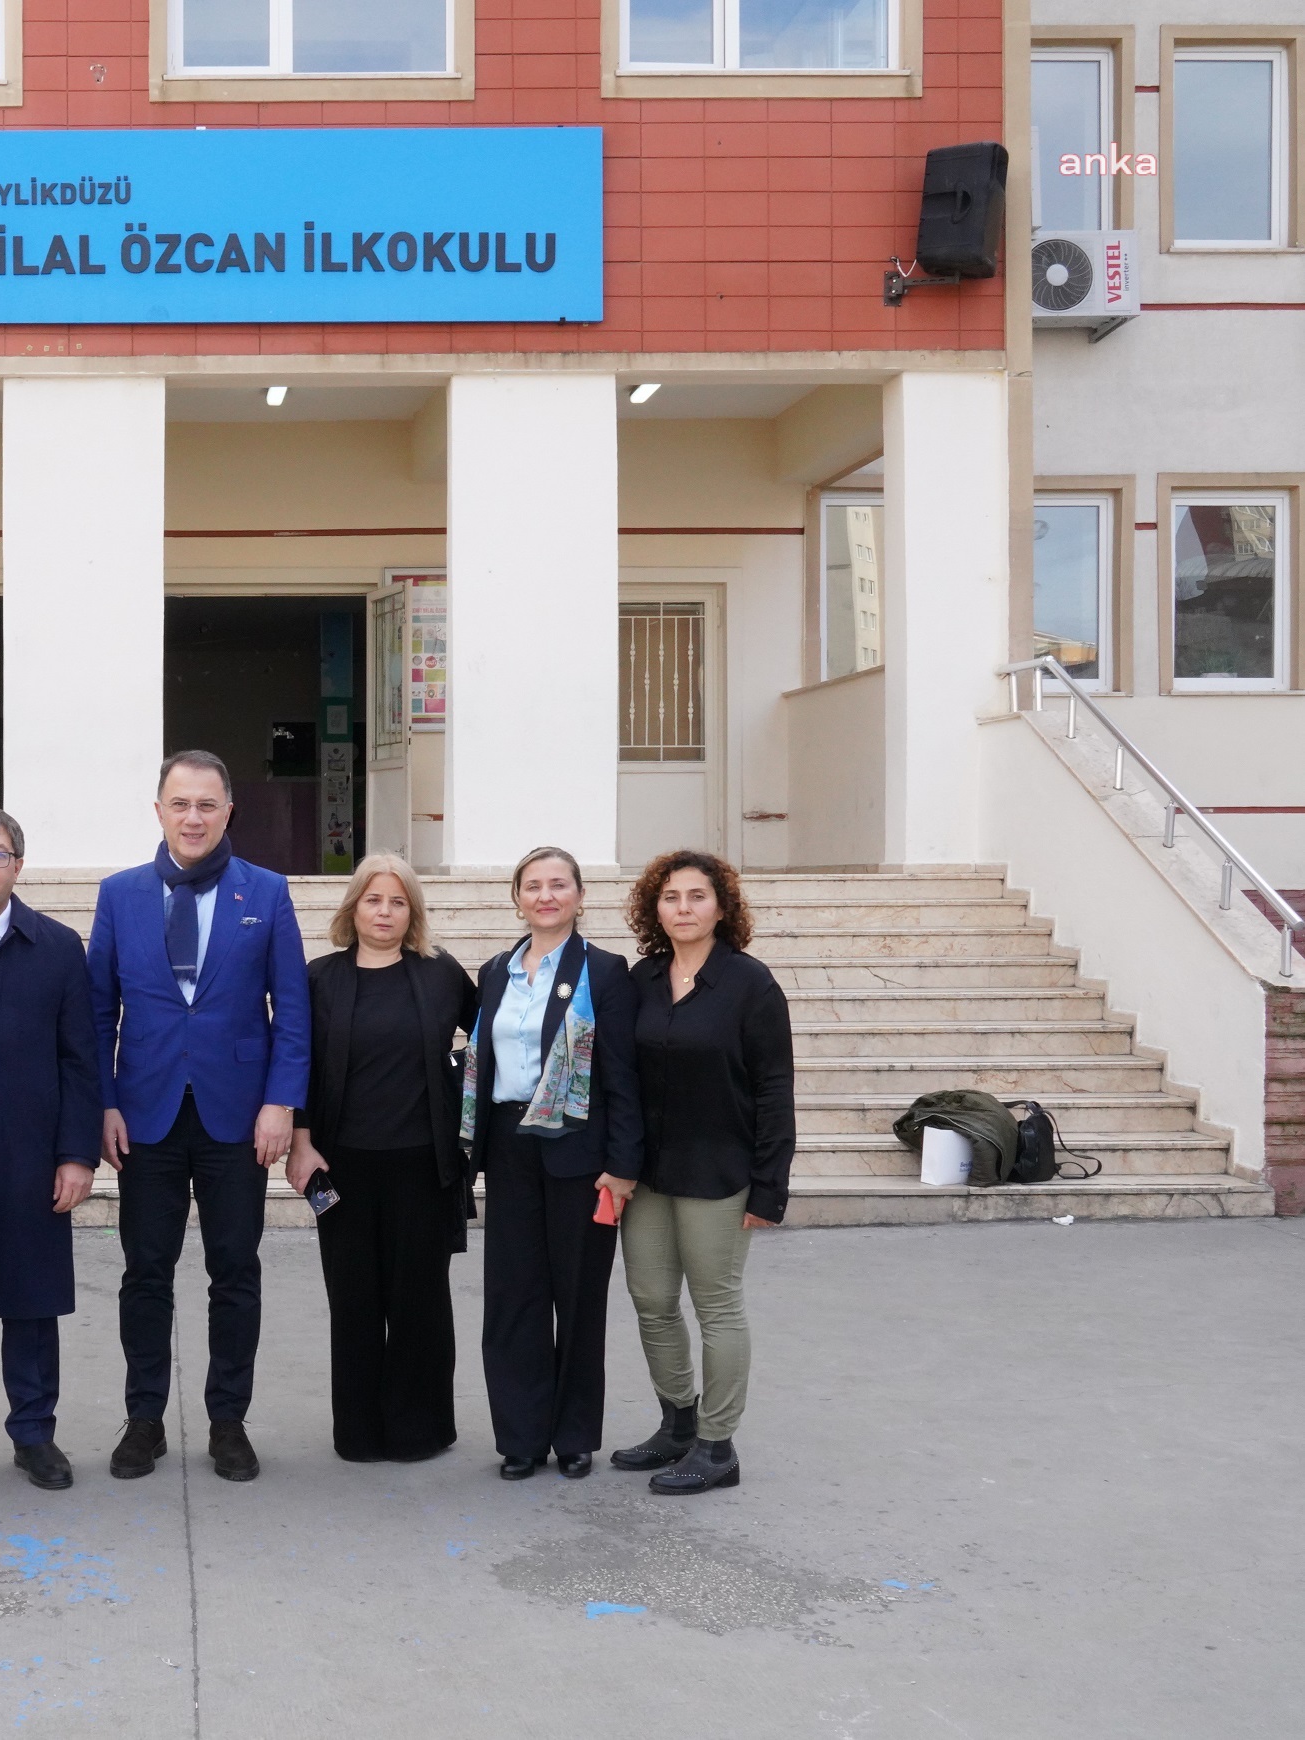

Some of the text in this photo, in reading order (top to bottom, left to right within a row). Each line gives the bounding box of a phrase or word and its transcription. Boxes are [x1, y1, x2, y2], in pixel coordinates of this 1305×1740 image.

[120, 223, 286, 275] ÖZCAN
[304, 221, 557, 274] İLKOKULU
[1106, 240, 1122, 304] VESTEL
